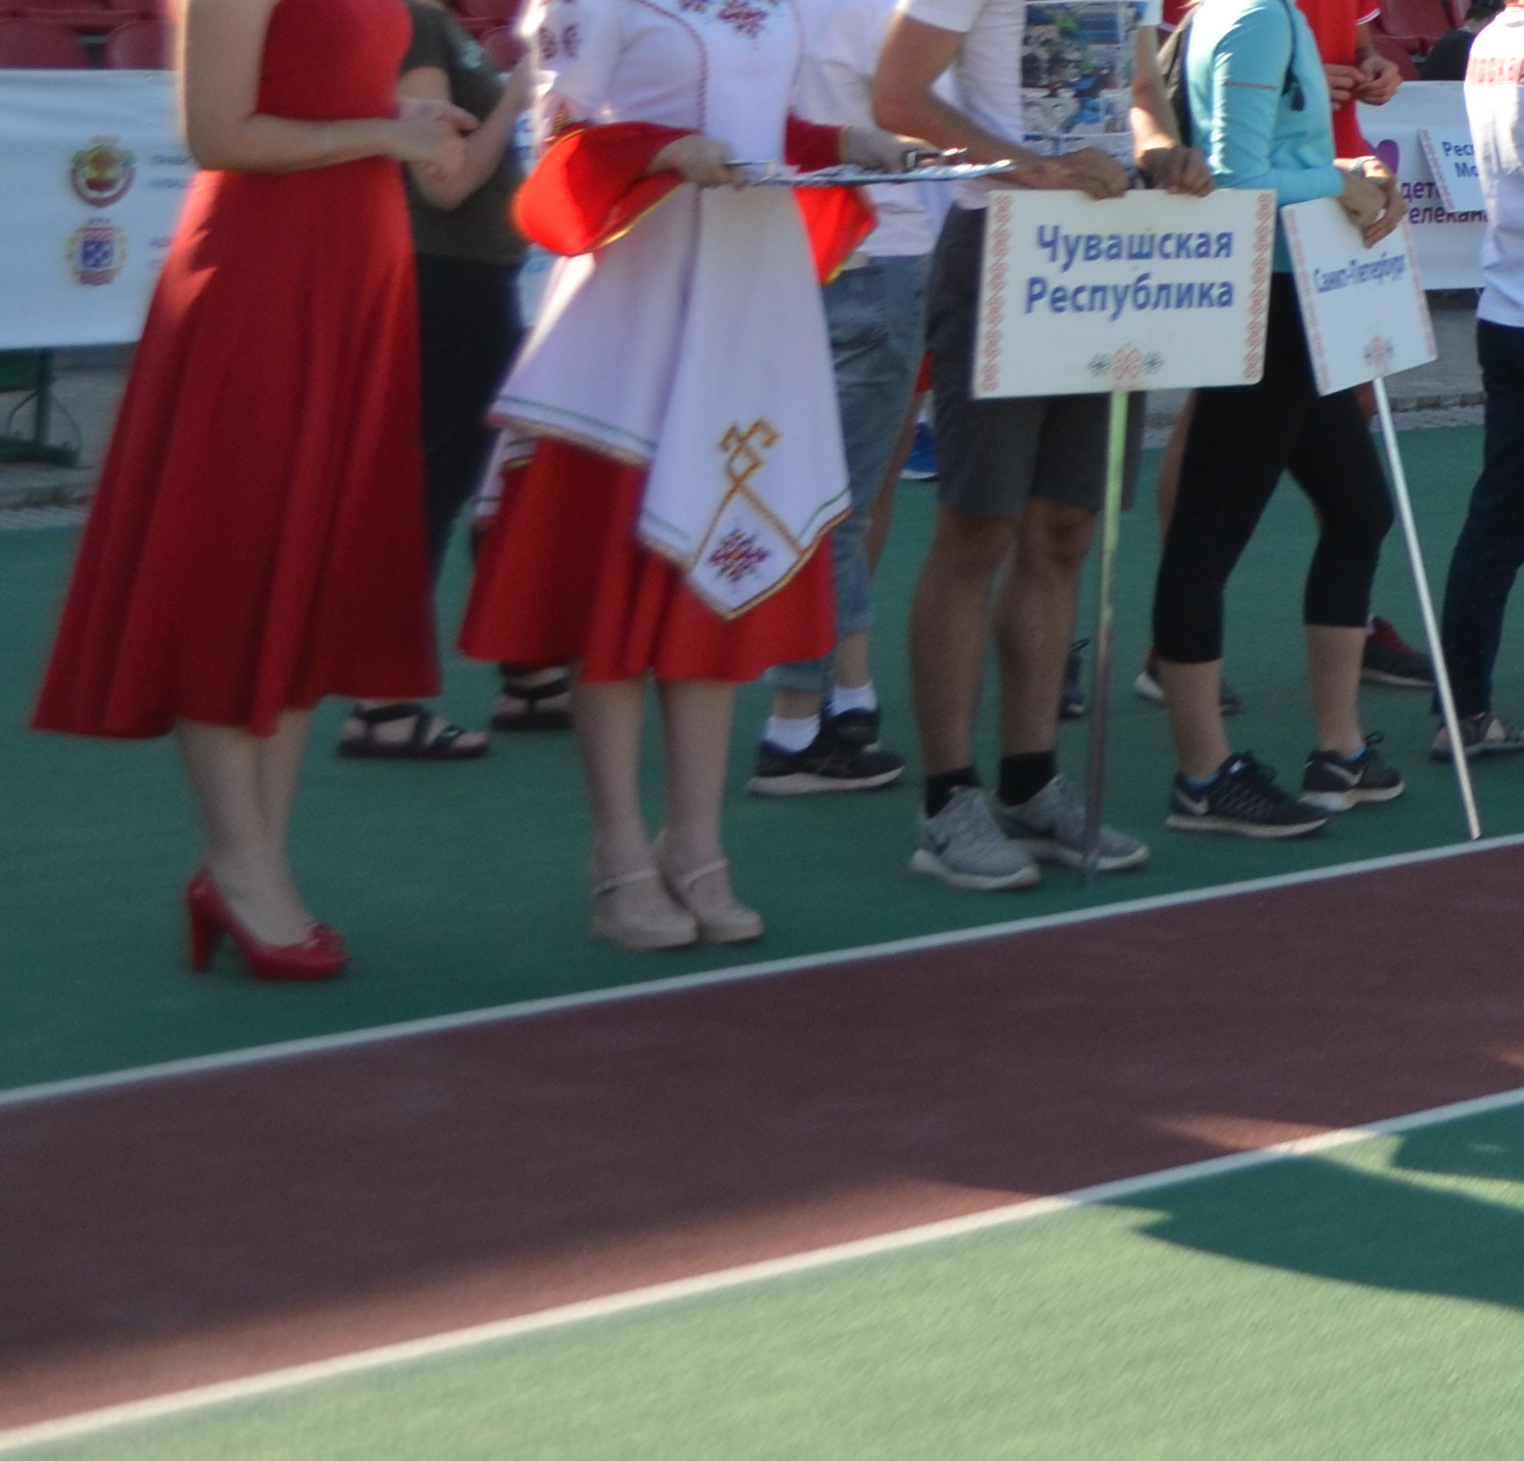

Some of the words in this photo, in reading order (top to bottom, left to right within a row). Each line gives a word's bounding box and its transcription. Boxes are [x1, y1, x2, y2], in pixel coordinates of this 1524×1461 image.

[1035, 224, 1235, 273] Чувашская
[1313, 251, 1406, 295] Санкт-Петербург
[1023, 271, 1235, 323] Республика
